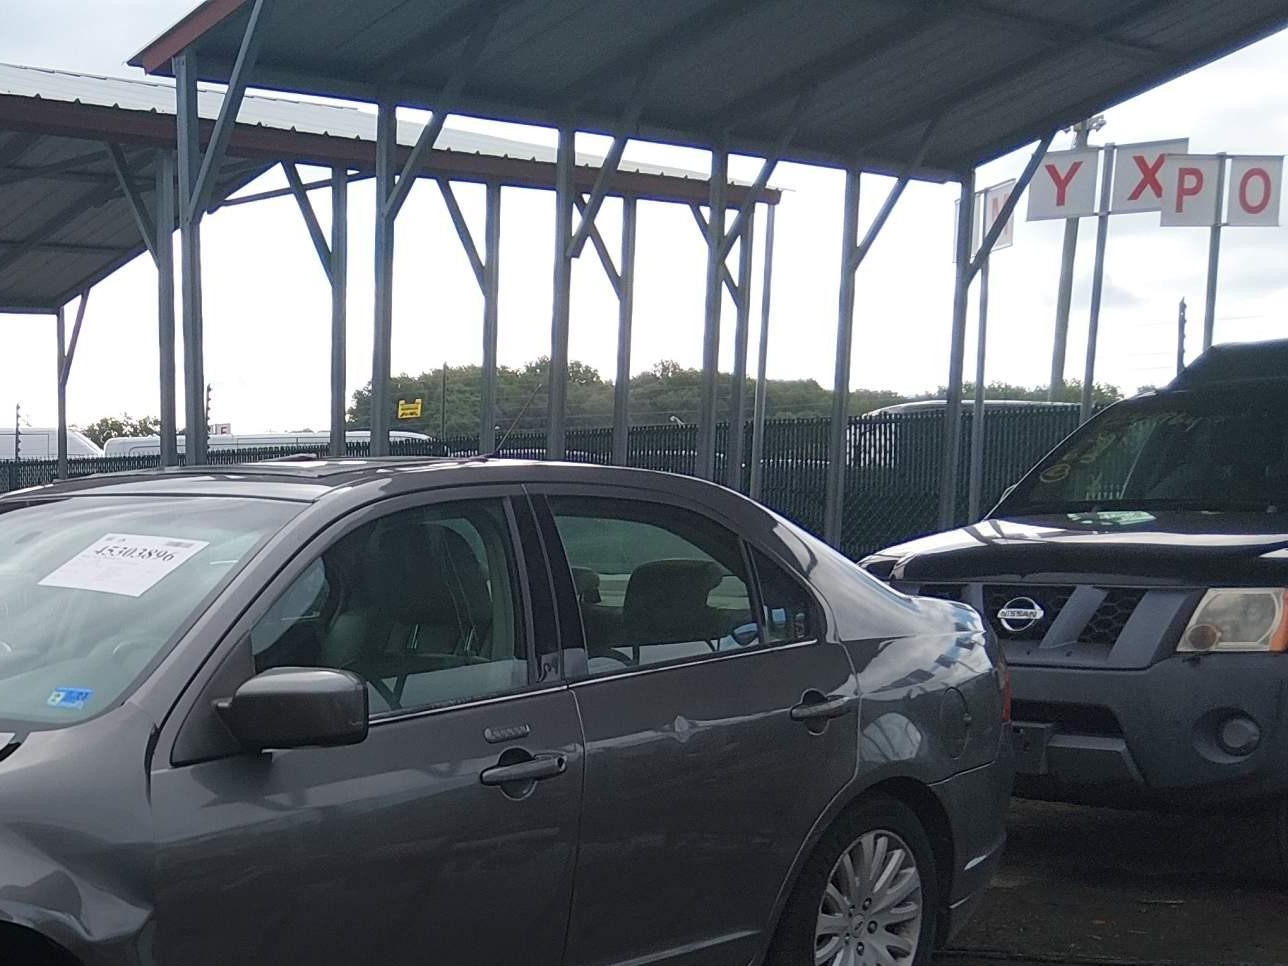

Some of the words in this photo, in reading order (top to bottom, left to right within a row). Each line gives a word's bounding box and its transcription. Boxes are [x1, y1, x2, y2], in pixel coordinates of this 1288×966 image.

[1045, 161, 1084, 207] Y
[1128, 153, 1166, 201] X
[1175, 167, 1204, 213] P
[1239, 167, 1272, 214] O
[999, 609, 1039, 618] NISSAN
